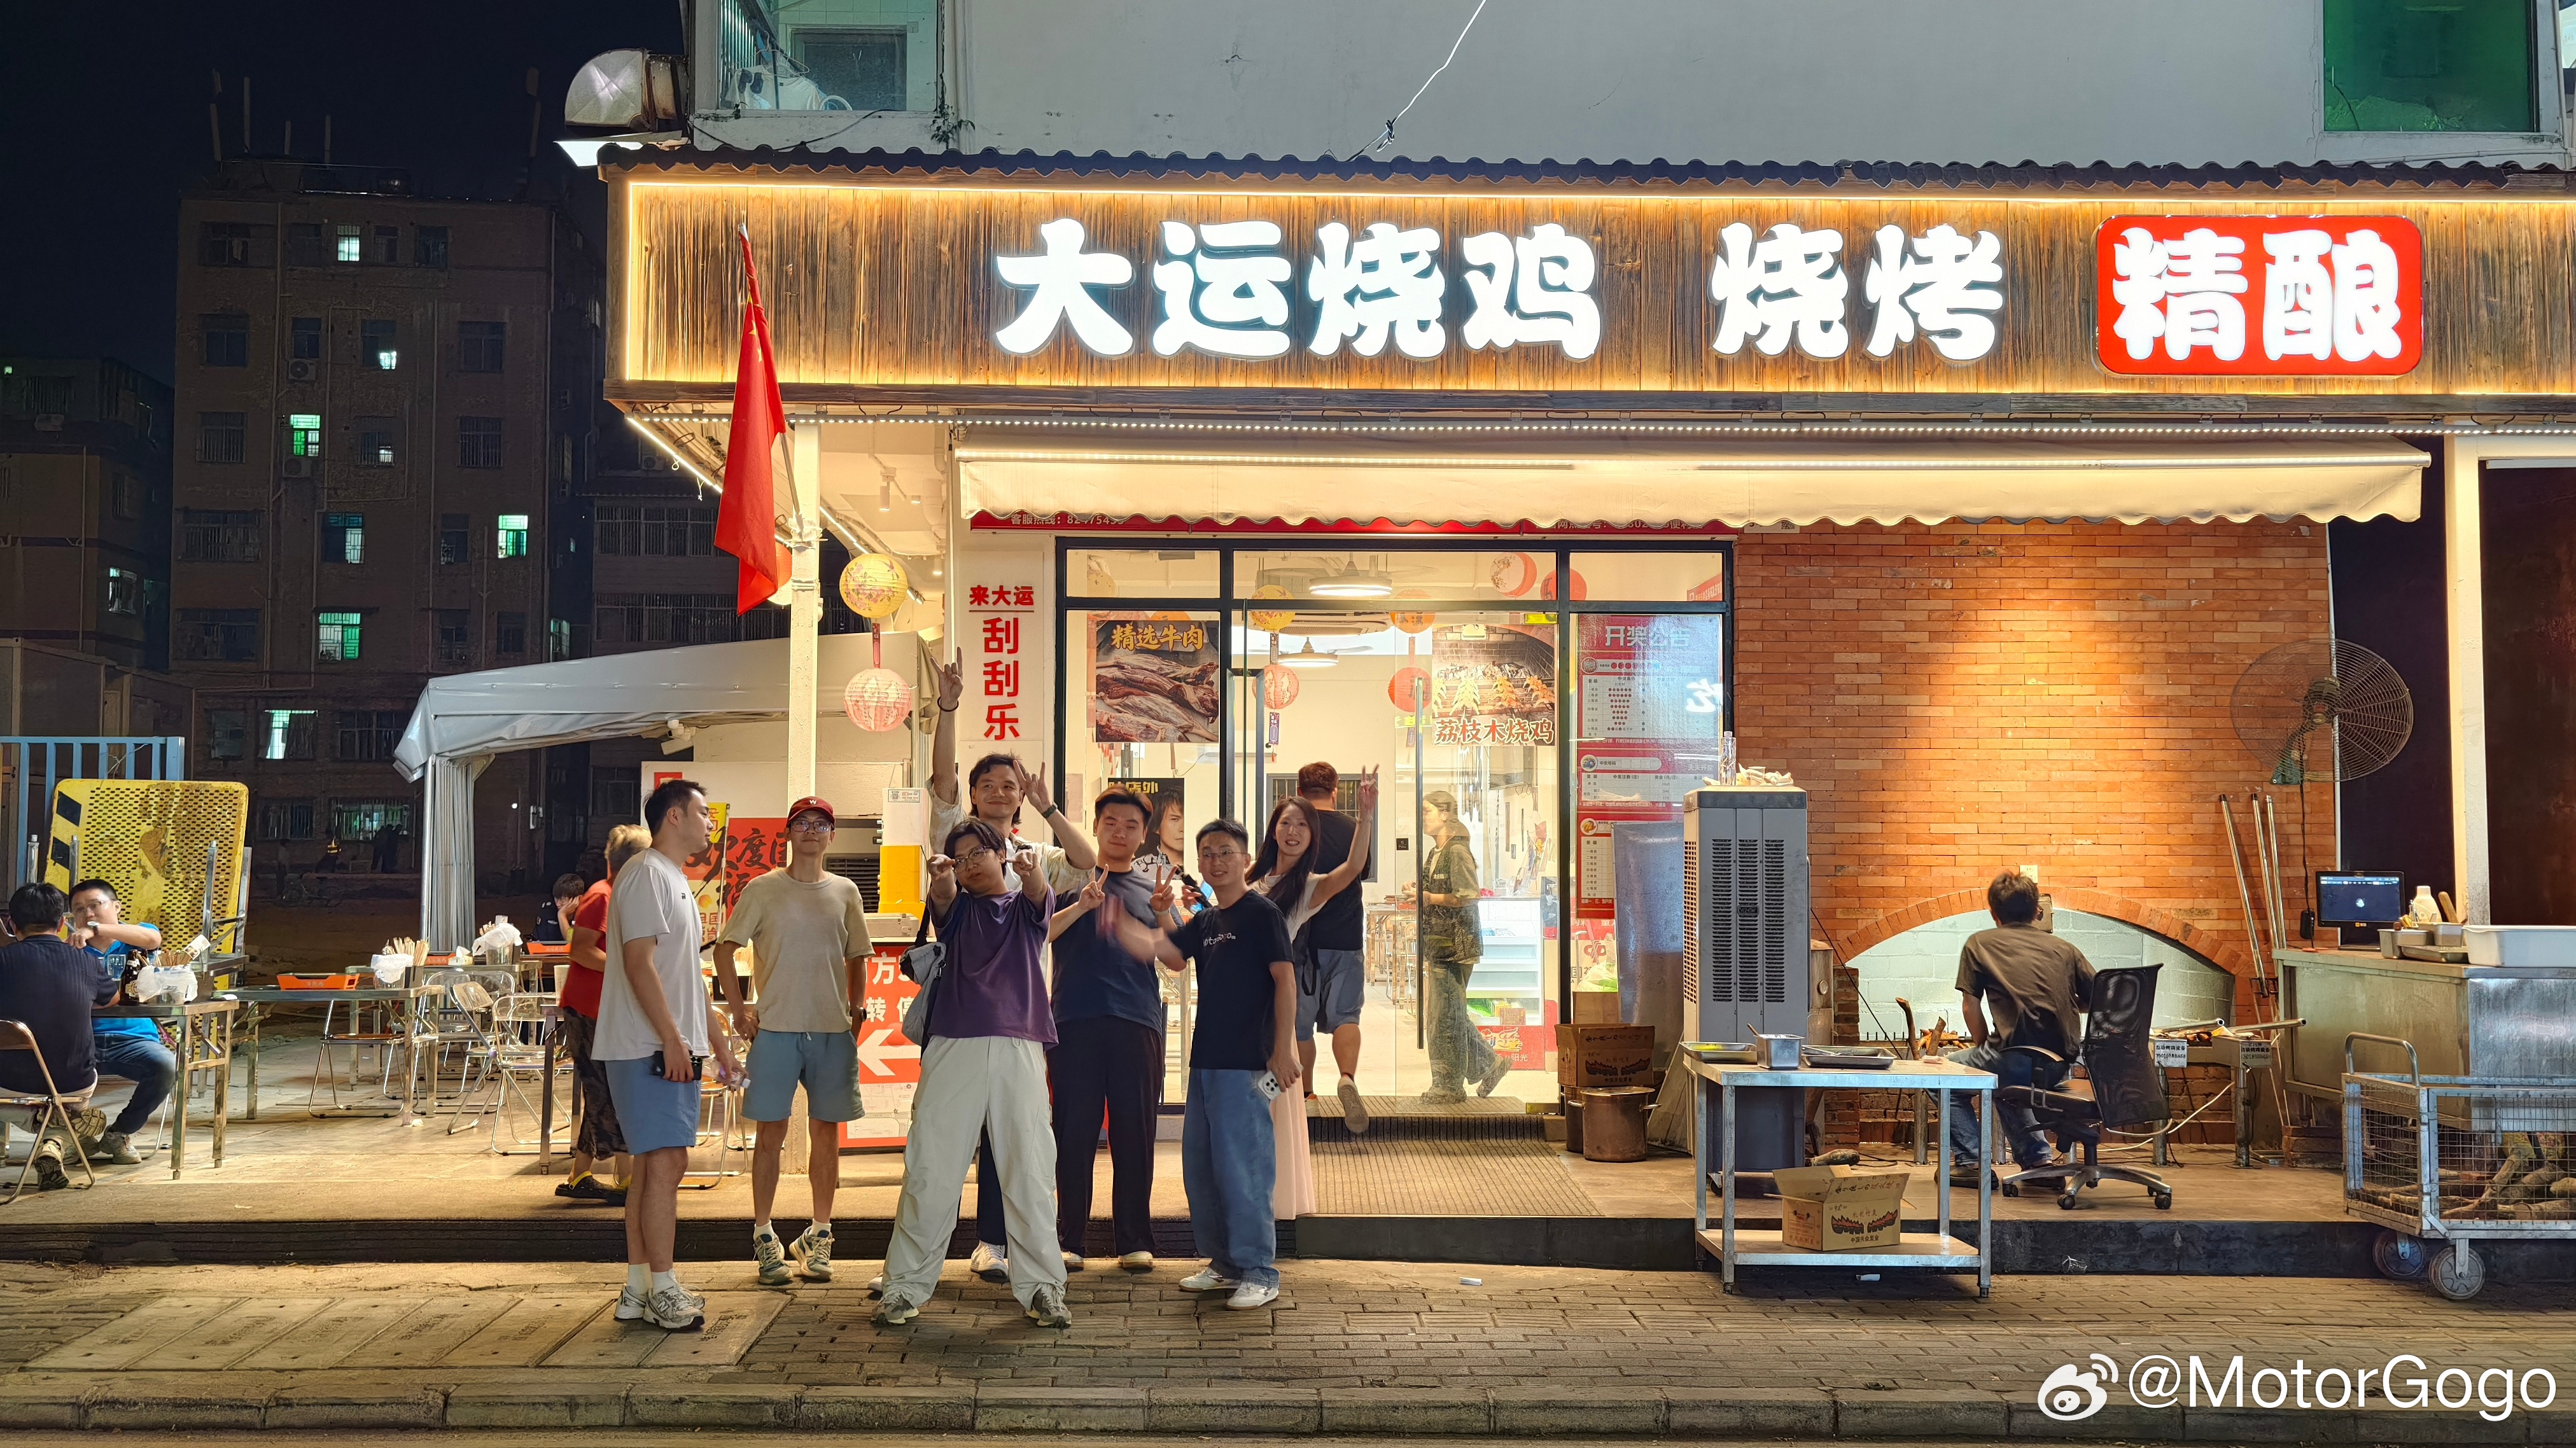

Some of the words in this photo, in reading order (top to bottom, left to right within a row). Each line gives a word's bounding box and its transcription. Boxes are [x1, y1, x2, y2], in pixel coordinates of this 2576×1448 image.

[995, 218, 1601, 360] 大运烧鸡
[1711, 222, 2003, 360] 烧烤
[2112, 226, 2402, 361] 精酿
[969, 585, 1035, 606] 来大运
[1111, 623, 1204, 651] 精选牛肉
[1605, 625, 1690, 648] 开奖公告
[982, 616, 1020, 741] 刮刮乐
[1433, 718, 1555, 745] 荔枝木烧鸡
[1511, 1053, 1528, 1062] 阳光
